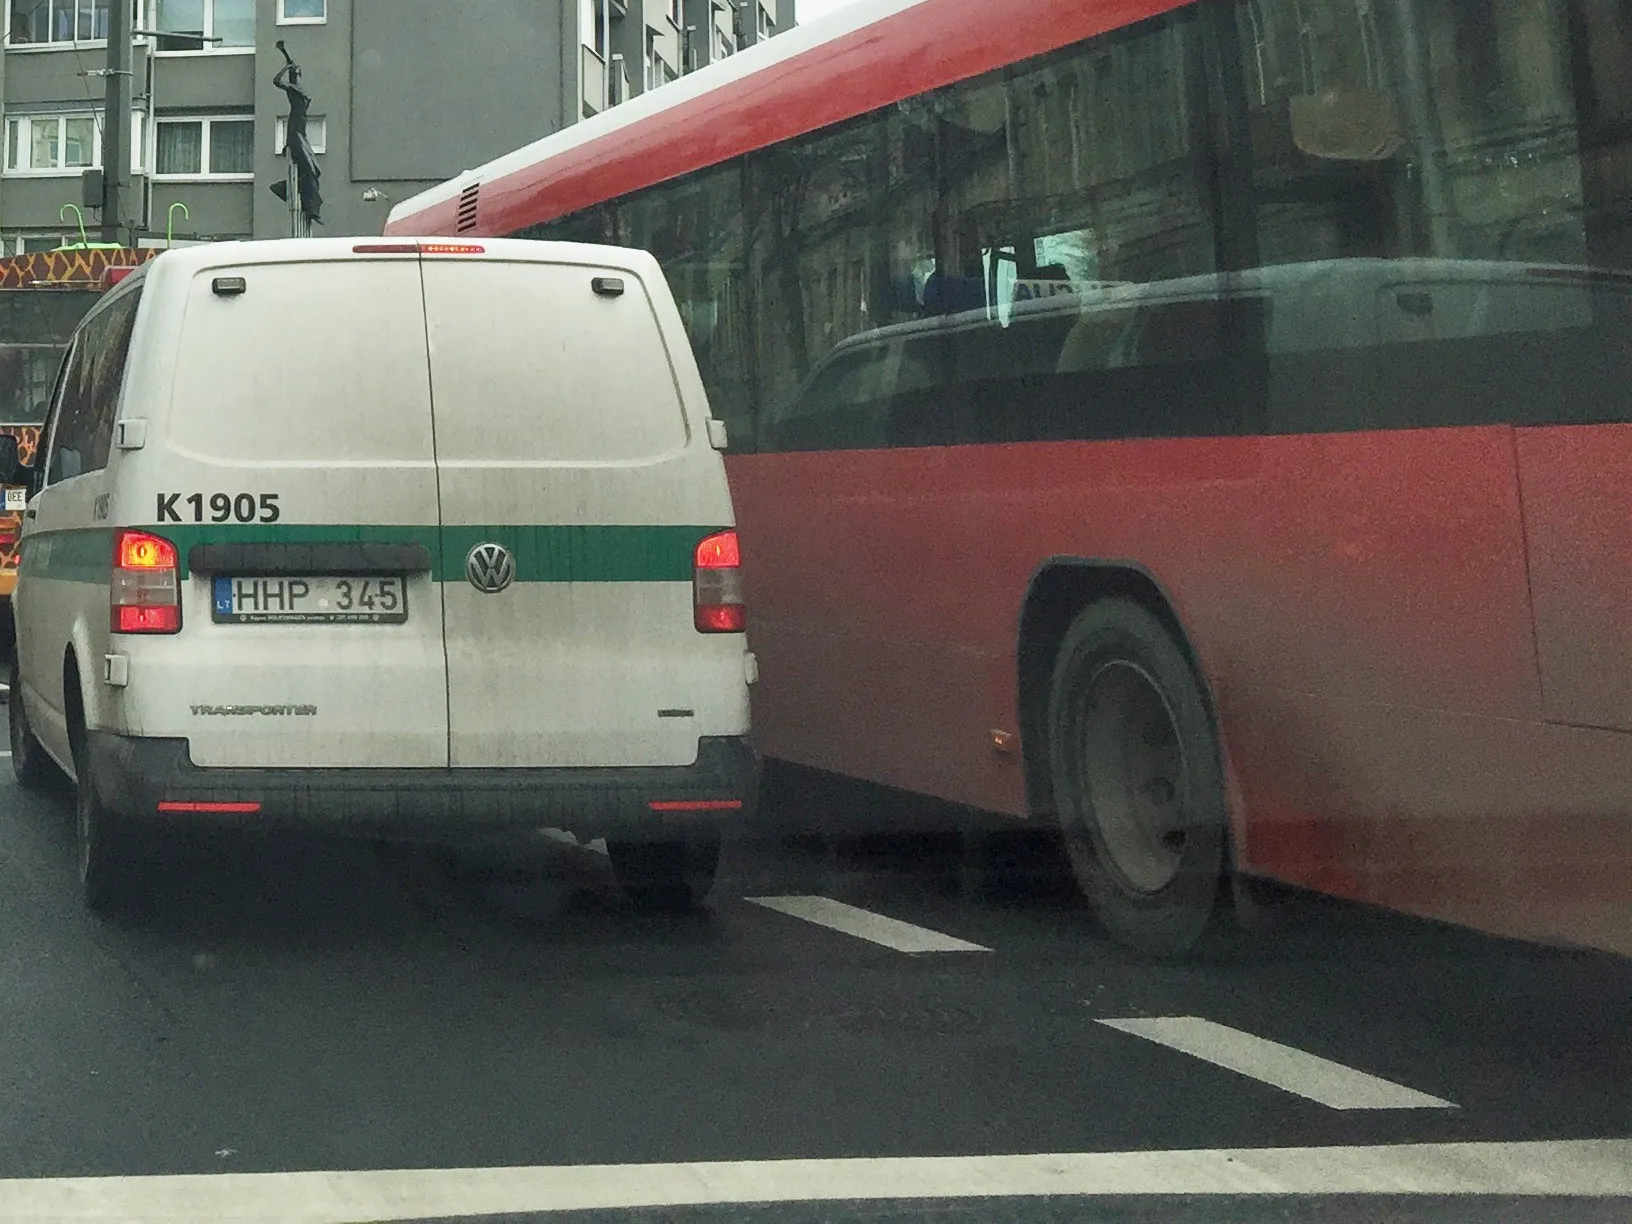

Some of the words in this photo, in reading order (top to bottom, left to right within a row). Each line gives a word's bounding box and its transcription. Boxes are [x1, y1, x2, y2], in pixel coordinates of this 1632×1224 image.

[156, 492, 280, 523] K1905
[236, 580, 310, 611] HHP
[335, 580, 398, 611] 345
